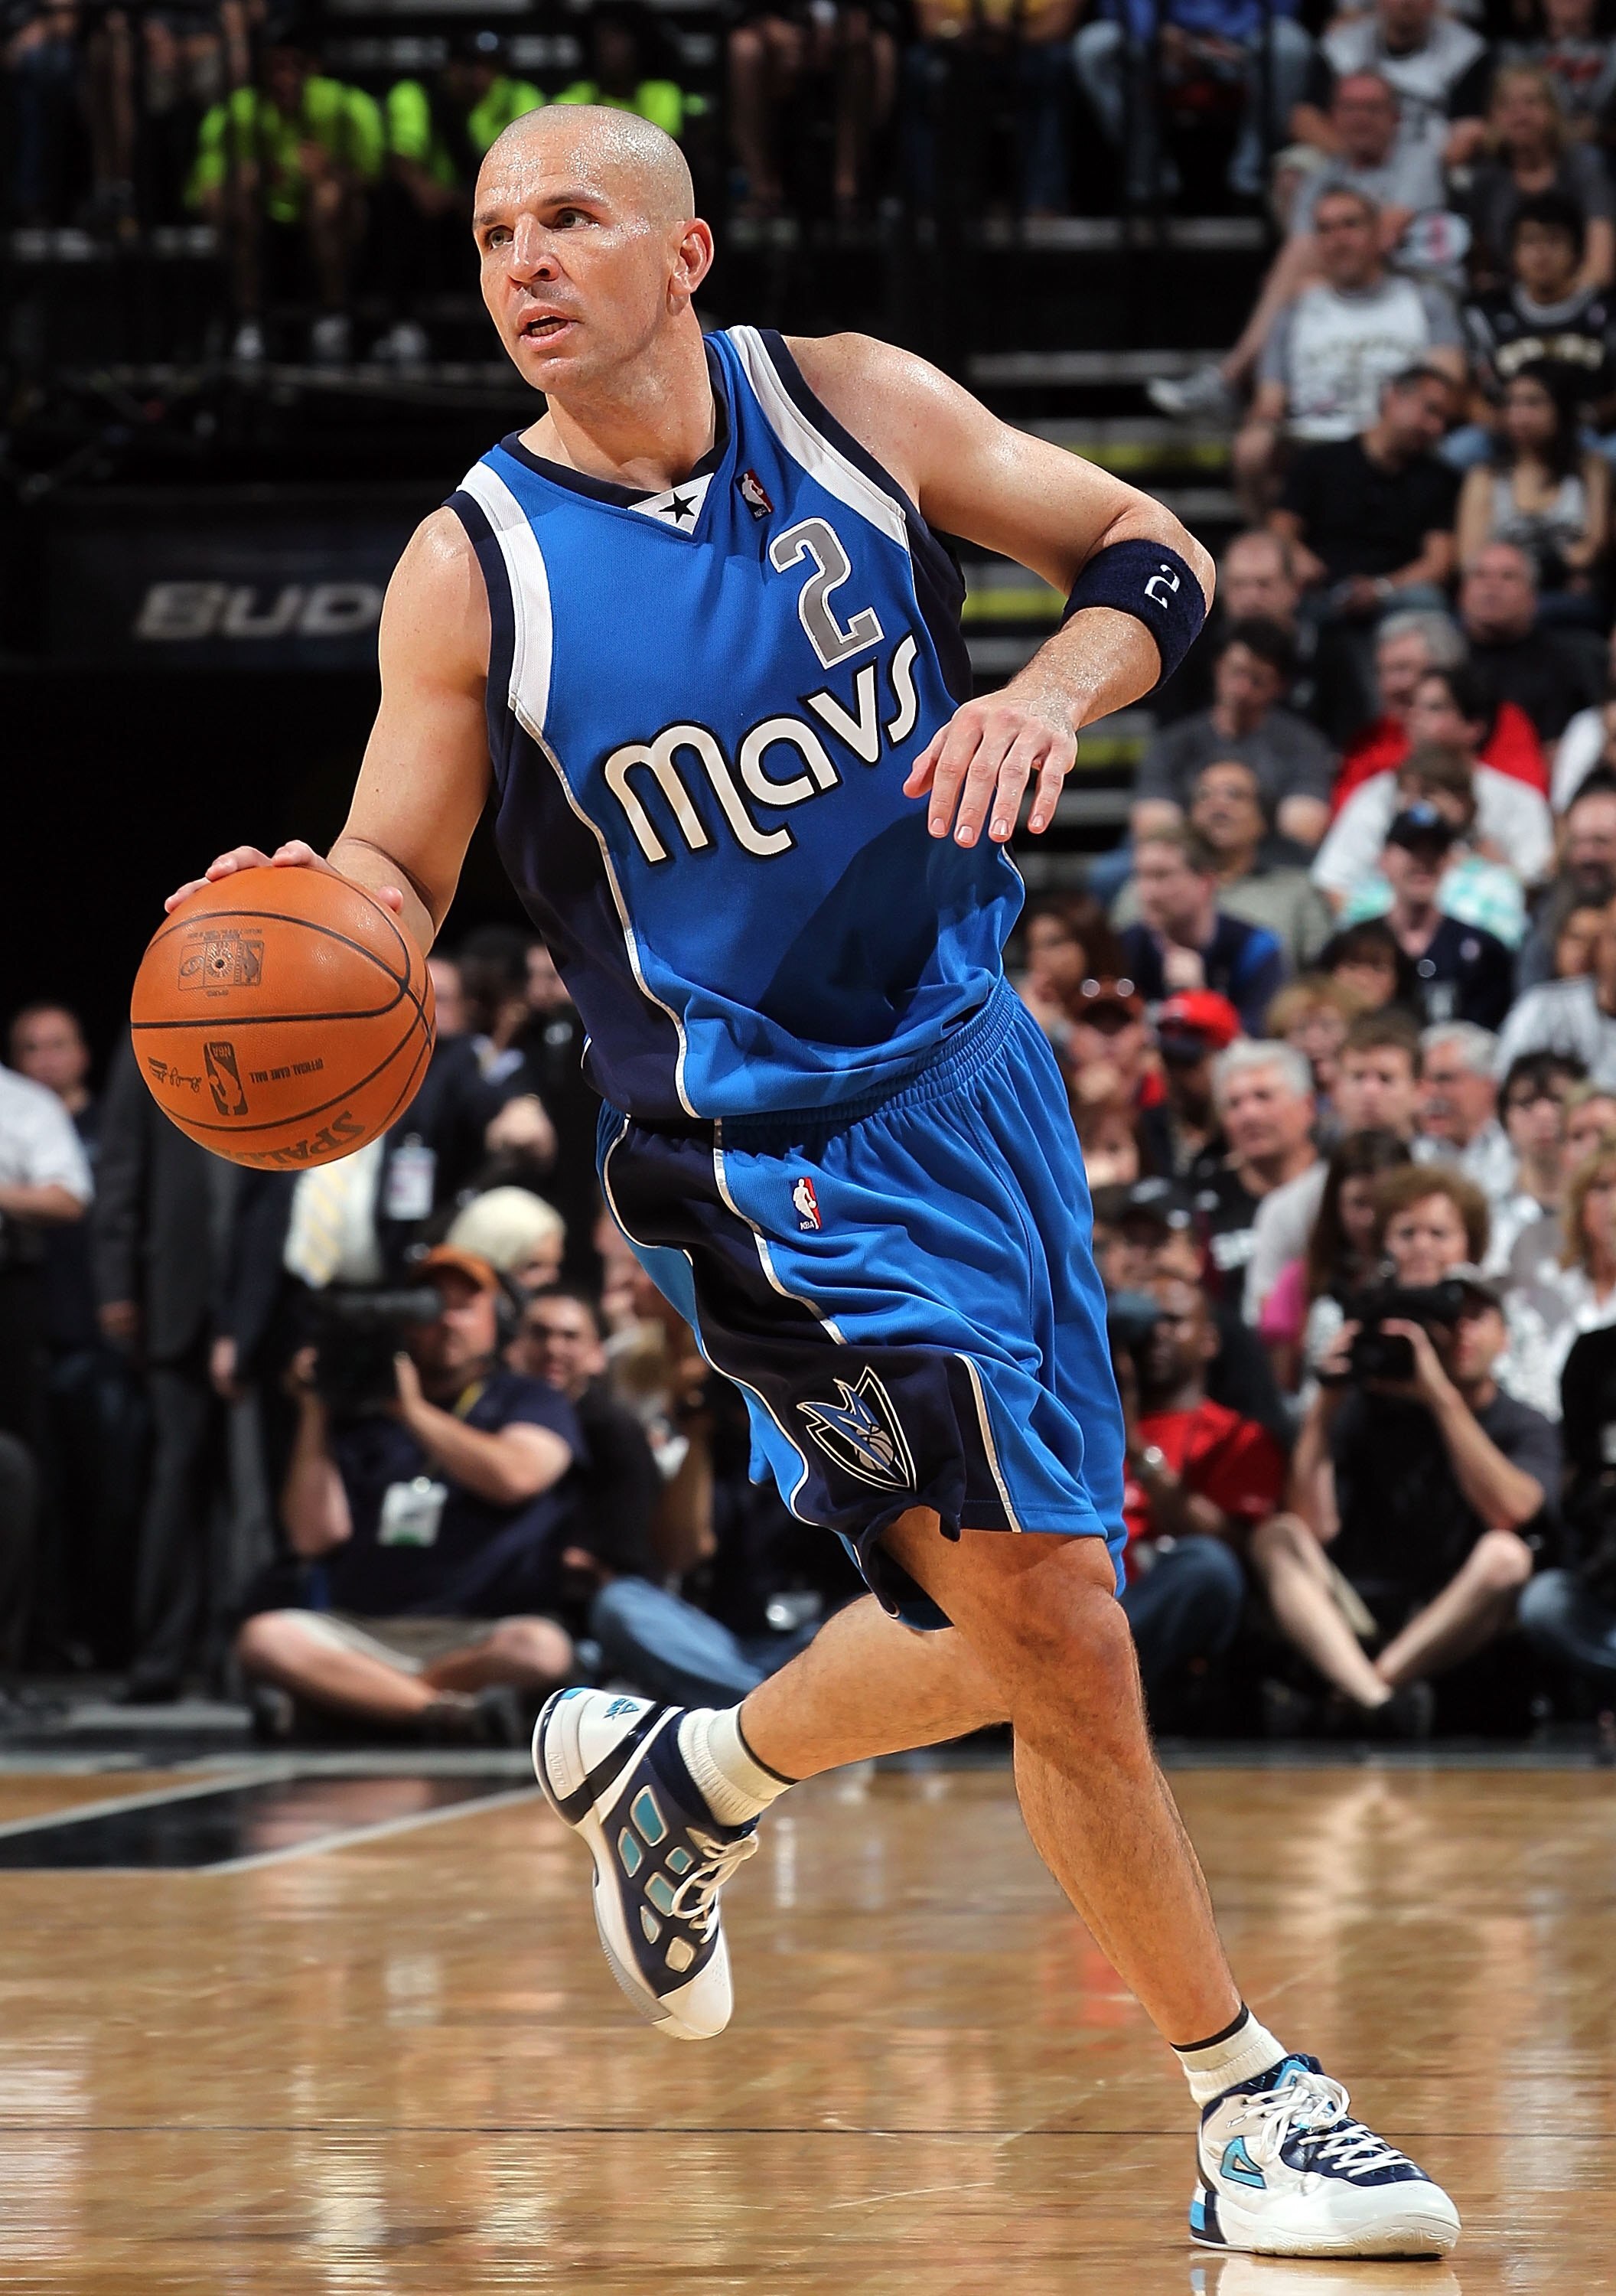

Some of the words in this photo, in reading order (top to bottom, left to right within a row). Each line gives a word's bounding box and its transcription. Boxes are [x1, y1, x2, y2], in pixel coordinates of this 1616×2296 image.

[769, 517, 885, 670] 2
[1144, 563, 1181, 609] 2
[136, 582, 384, 640] BUD
[213, 1045, 232, 1058] NBA
[272, 1068, 290, 1081] GAME
[294, 1058, 324, 1076] OFFICIAL
[249, 1071, 269, 1084] BALL
[800, 1221, 815, 1231] NBA
